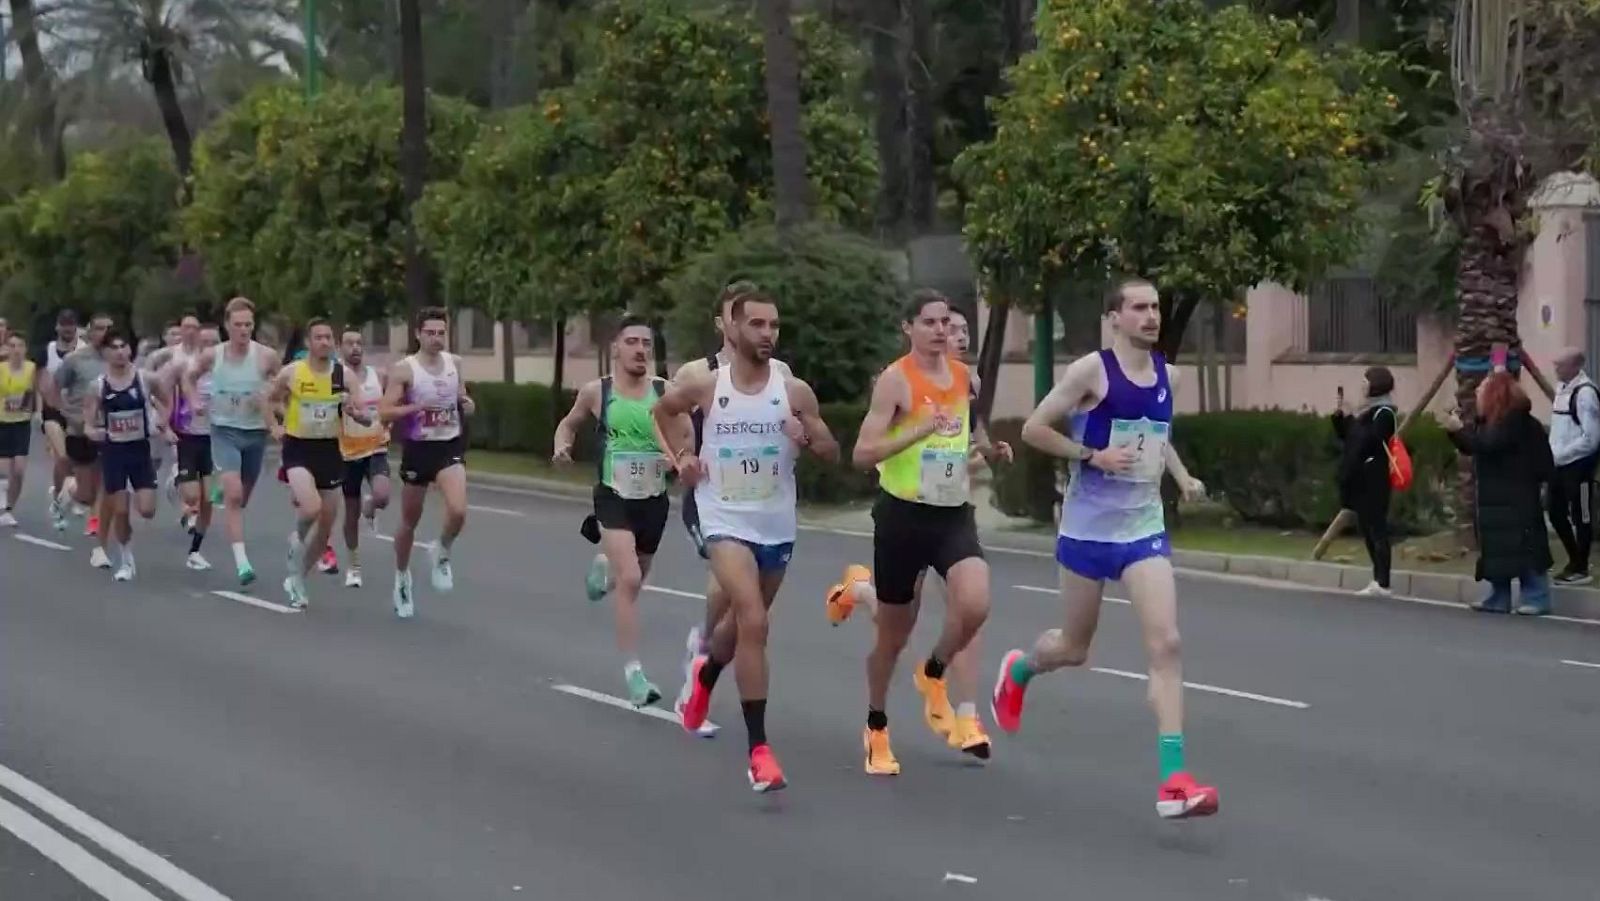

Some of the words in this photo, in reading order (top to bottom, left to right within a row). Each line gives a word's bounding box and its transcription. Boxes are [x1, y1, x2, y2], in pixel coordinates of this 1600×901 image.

[1137, 433, 1146, 450] 2
[740, 458, 759, 475] 19
[945, 463, 954, 477] 8
